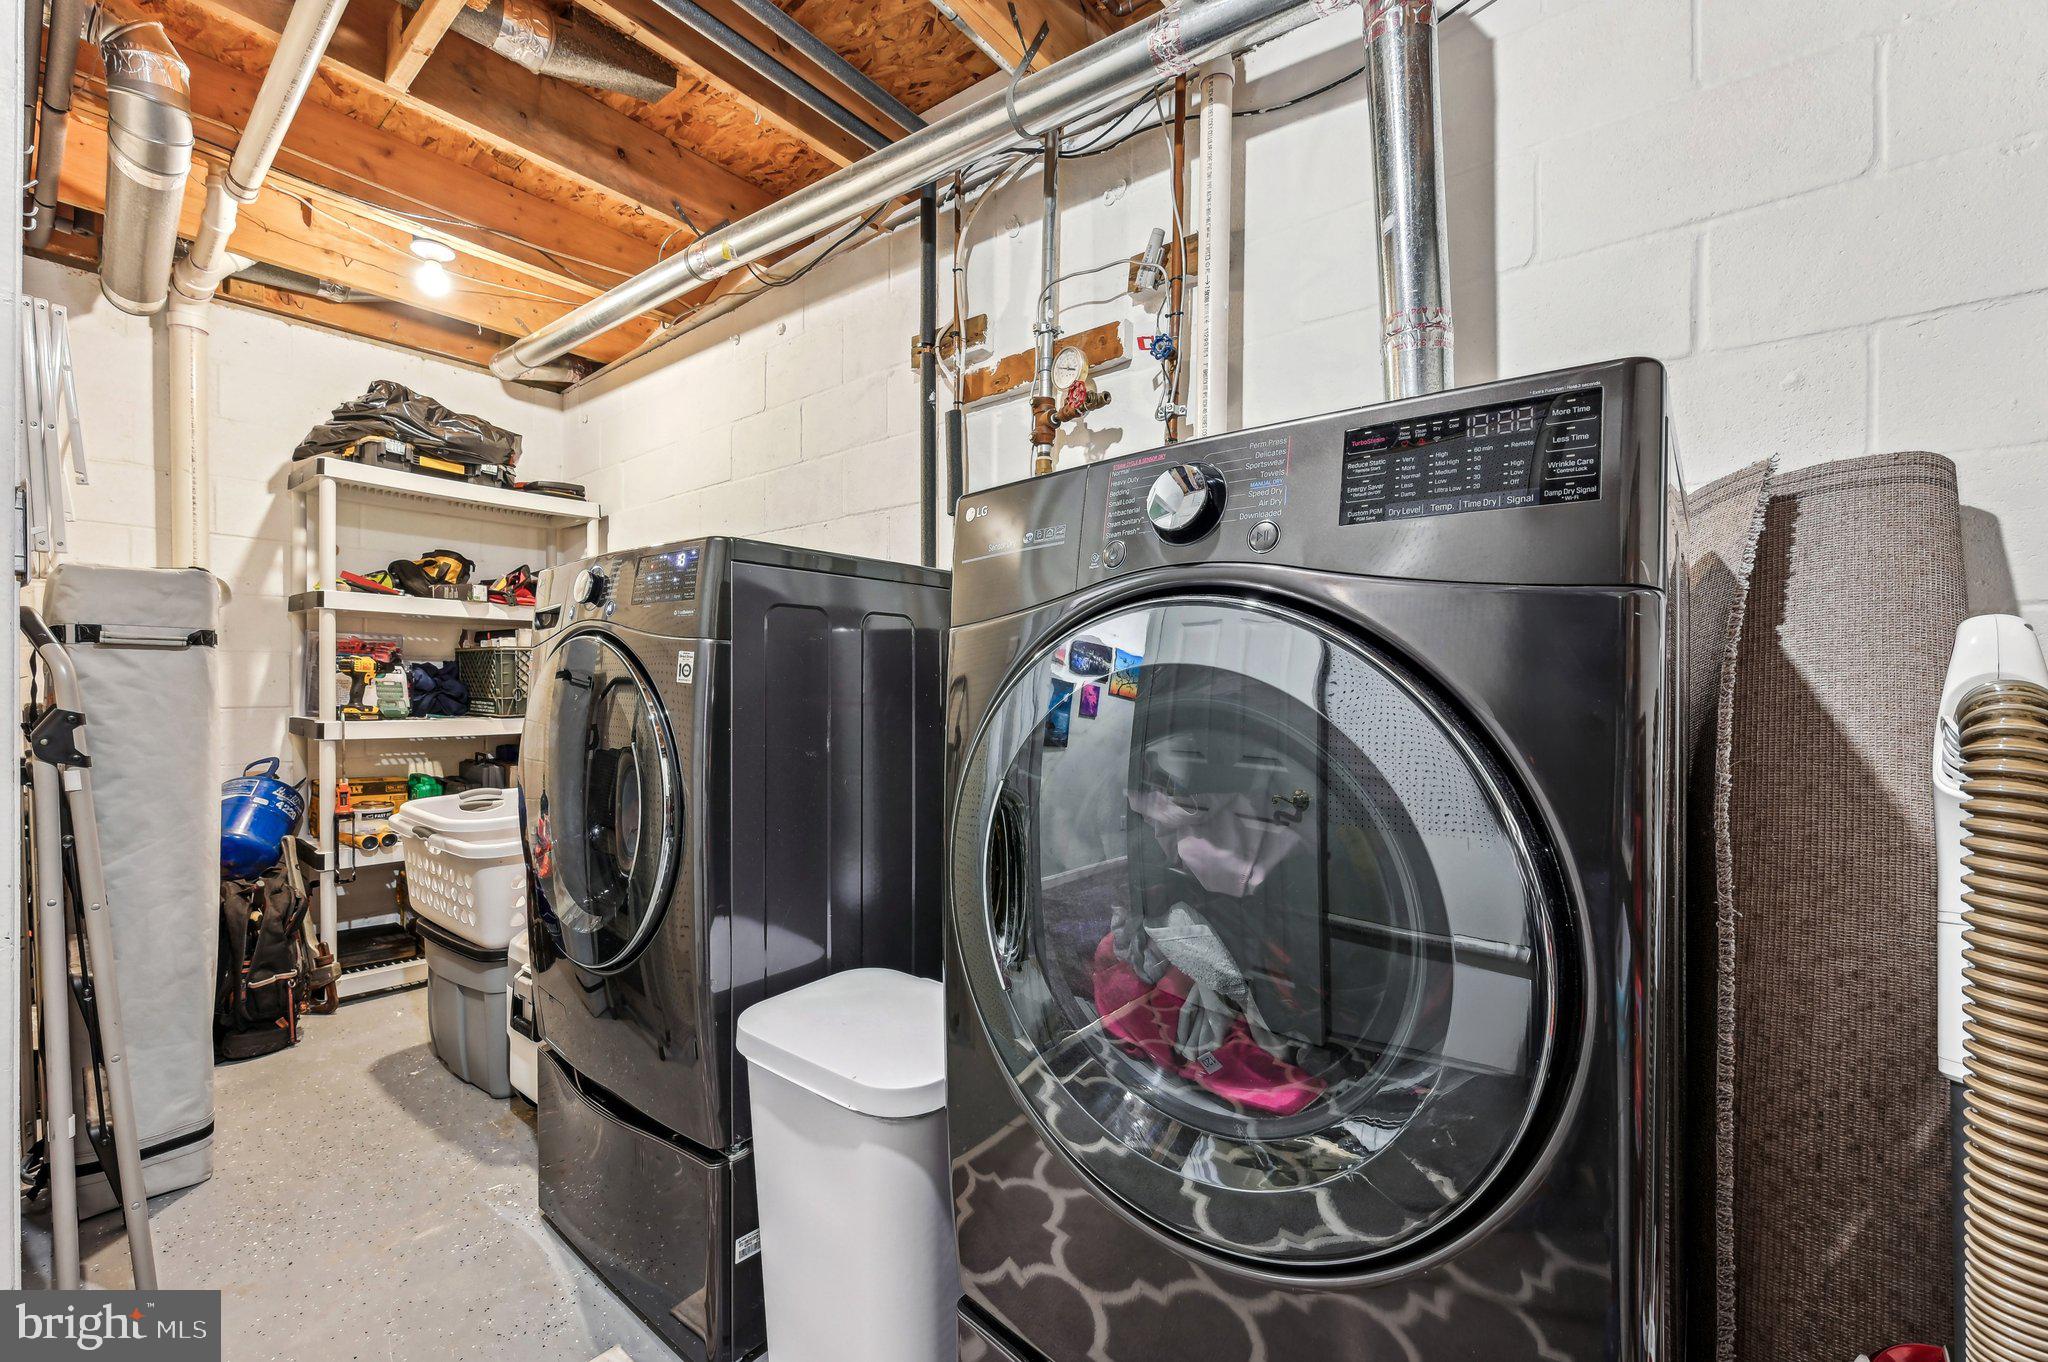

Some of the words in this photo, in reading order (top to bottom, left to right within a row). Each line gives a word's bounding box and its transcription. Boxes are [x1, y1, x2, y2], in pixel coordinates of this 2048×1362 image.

[1552, 408, 1571, 416] More
[1250, 441, 1268, 449] Perm.
[1269, 438, 1287, 446] Press
[1351, 437, 1386, 447] TurboSteam
[1511, 440, 1534, 448] Remote
[1255, 450, 1287, 459] Delicates
[1245, 459, 1285, 471] Sportswear
[1347, 461, 1368, 470] Reduce
[1548, 460, 1575, 468] Wrinkle
[1112, 468, 1130, 477] Normal
[1261, 469, 1285, 478] Towels
[1401, 472, 1421, 480] Normal
[1434, 468, 1457, 476] Medium
[1111, 479, 1127, 487] Heavy
[1127, 476, 1140, 484] Duty
[1110, 489, 1130, 498] Bedding
[1248, 489, 1269, 498] Speed
[1271, 487, 1283, 495] Dry
[1347, 486, 1367, 494] Energy
[1576, 486, 1597, 495] Signal
[1108, 499, 1122, 508] Small
[1122, 497, 1136, 505] Load
[1270, 498, 1282, 506] Dry
[1463, 500, 1481, 508] Time
[1483, 498, 1497, 507] Dry
[1507, 494, 1534, 505] Signal
[976, 506, 988, 518] LG
[1108, 507, 1140, 518] Antibacterial
[1388, 509, 1400, 518] Dry
[1402, 506, 1421, 515] Level
[1430, 504, 1455, 513] Temp.
[1240, 510, 1282, 520] Downloaded
[1107, 521, 1120, 529] Steam
[1106, 532, 1121, 540] Steam
[679, 663, 692, 678] 10
